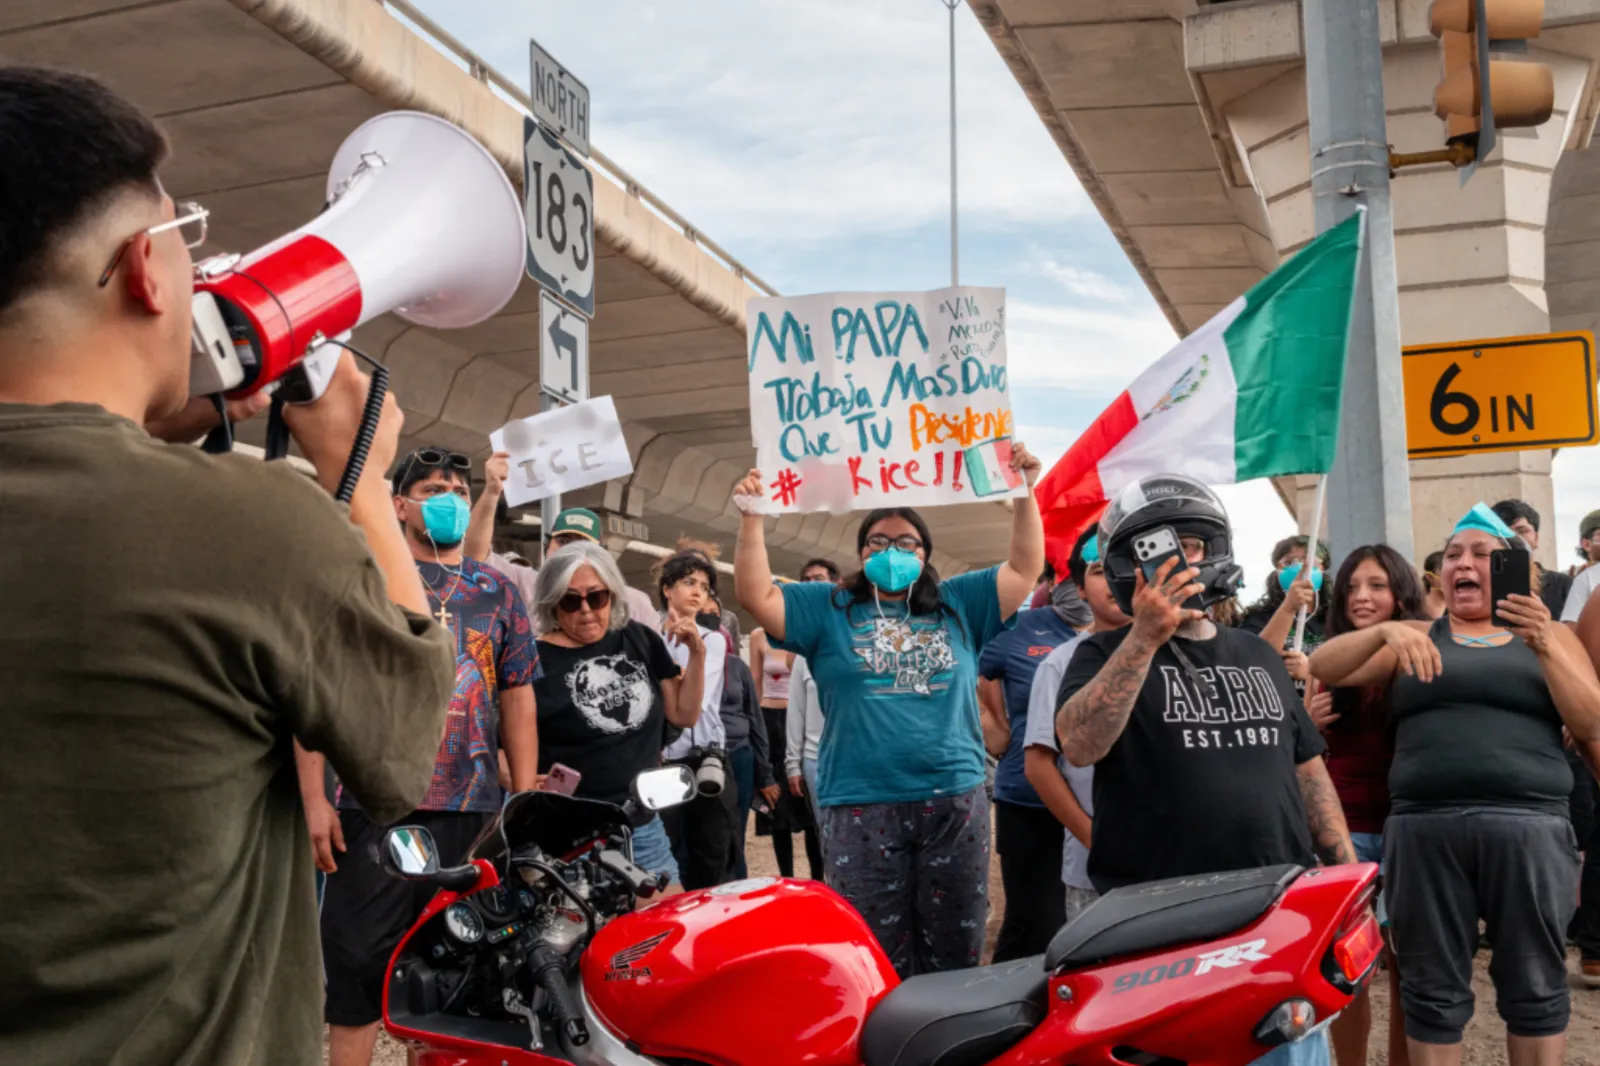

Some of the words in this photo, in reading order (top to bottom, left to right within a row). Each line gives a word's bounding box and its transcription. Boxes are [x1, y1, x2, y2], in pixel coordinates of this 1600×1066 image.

[534, 60, 587, 140] NORTH
[533, 160, 589, 272] 183
[749, 310, 815, 373] Mi
[831, 300, 930, 365] PAPA
[1430, 362, 1480, 436] 6
[1490, 393, 1535, 433] IN
[517, 442, 605, 489] ICE
[1160, 665, 1285, 723] AERO
[604, 966, 652, 982] HONDA
